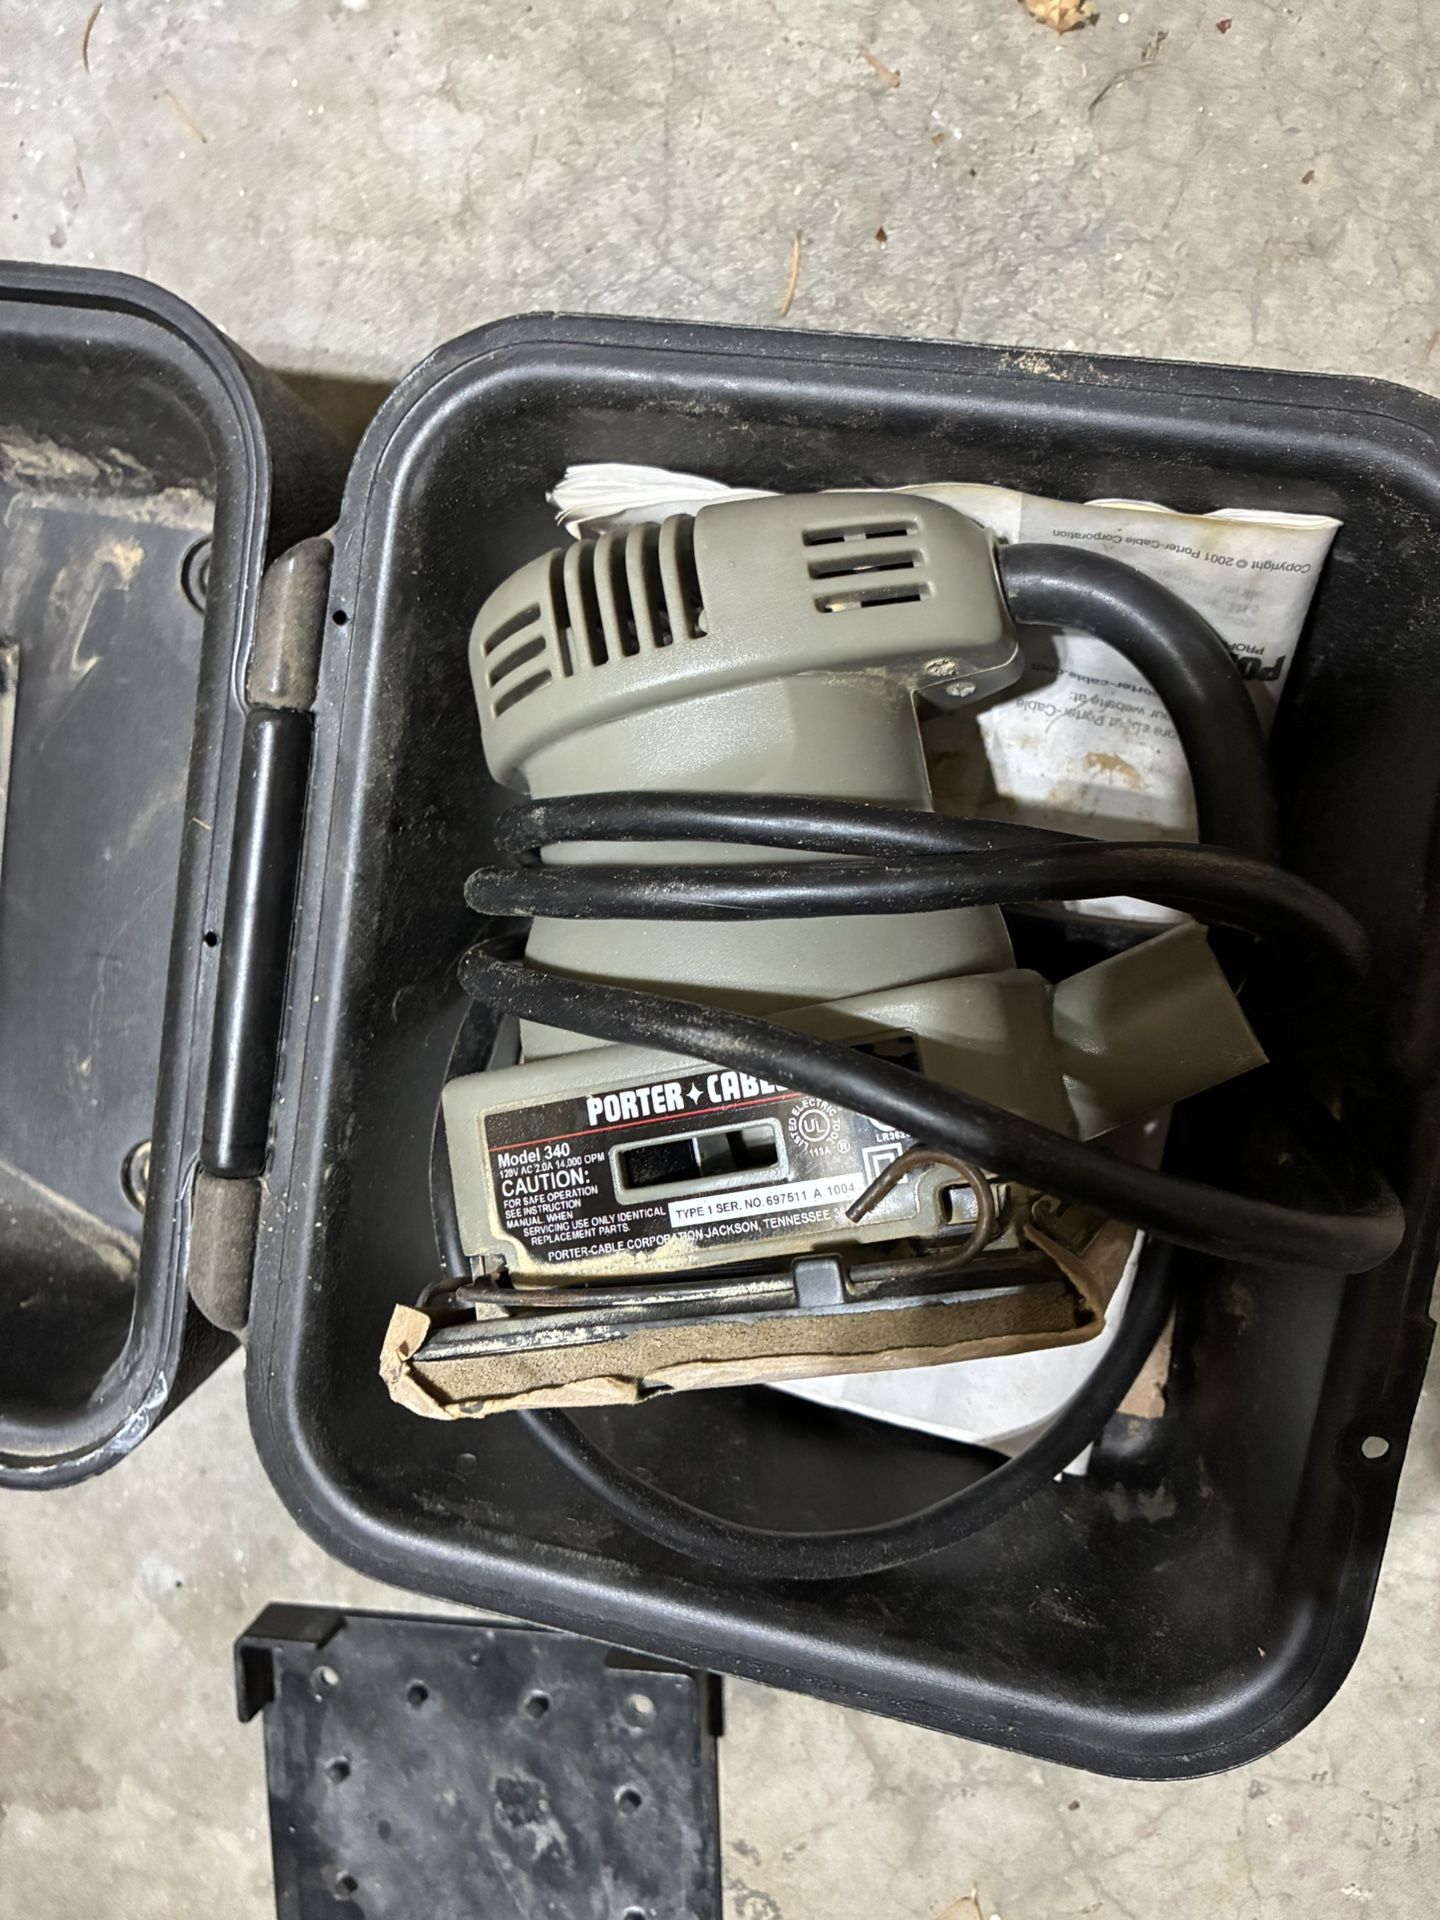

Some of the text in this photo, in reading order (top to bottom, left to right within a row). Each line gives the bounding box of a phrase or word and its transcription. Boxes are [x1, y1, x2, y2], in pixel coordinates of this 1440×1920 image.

[1052, 528, 1122, 544] Corporation
[1125, 535, 1200, 559] Porter-Cable
[1204, 552, 1234, 567] 2001
[1251, 560, 1311, 574] Copyright
[1016, 699, 1104, 727] Porter-Cable
[1089, 694, 1145, 716] website
[586, 1071, 789, 1126] PORTER CABL
[788, 1098, 841, 1151] LISTED ELECTRIC TOOL
[803, 1118, 825, 1133] UL
[498, 1142, 570, 1168] Model 340
[521, 1165, 533, 1176] AC
[584, 1152, 605, 1164] OPM
[809, 1147, 832, 1158] 113A
[502, 1167, 590, 1197] CAUTION:
[503, 1185, 598, 1209] FOR SAFE OPERATION
[505, 1199, 581, 1219] SEE INSTRUCTION
[675, 1182, 855, 1220] TYPE 1 SER. NO. 697511 A 1004
[523, 1206, 667, 1237] SERVICING USE ONLY IDENTICAL
[546, 1210, 574, 1223] WHEN
[531, 1222, 631, 1246] REPLACEMENT PARTS.
[548, 1240, 624, 1261] PORTER-CABLE
[765, 1208, 832, 1229] TENNESSEE
